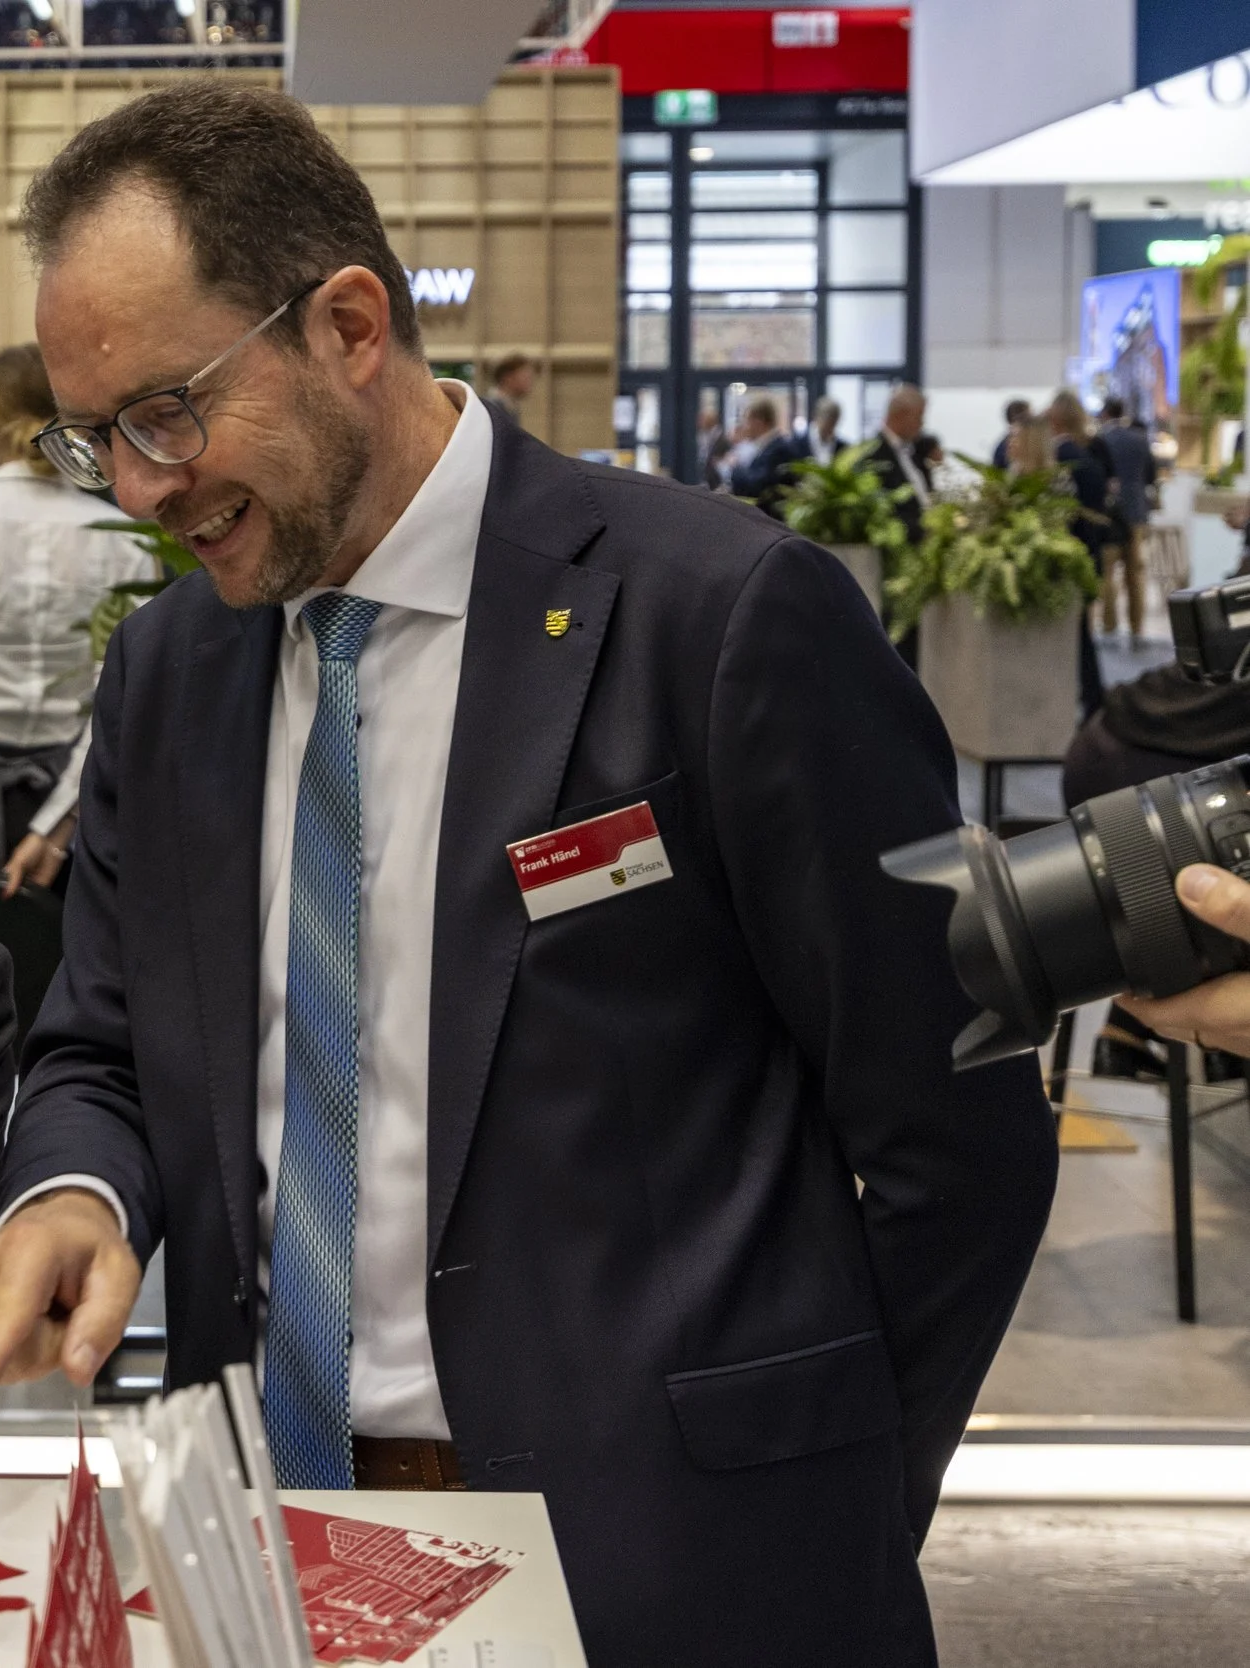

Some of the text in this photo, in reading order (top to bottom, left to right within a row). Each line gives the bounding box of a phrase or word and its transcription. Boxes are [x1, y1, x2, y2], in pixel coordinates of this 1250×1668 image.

[405, 267, 474, 305] AW
[520, 856, 549, 873] Frank
[550, 845, 581, 864] Hänel
[626, 861, 664, 878] SACHSEN
